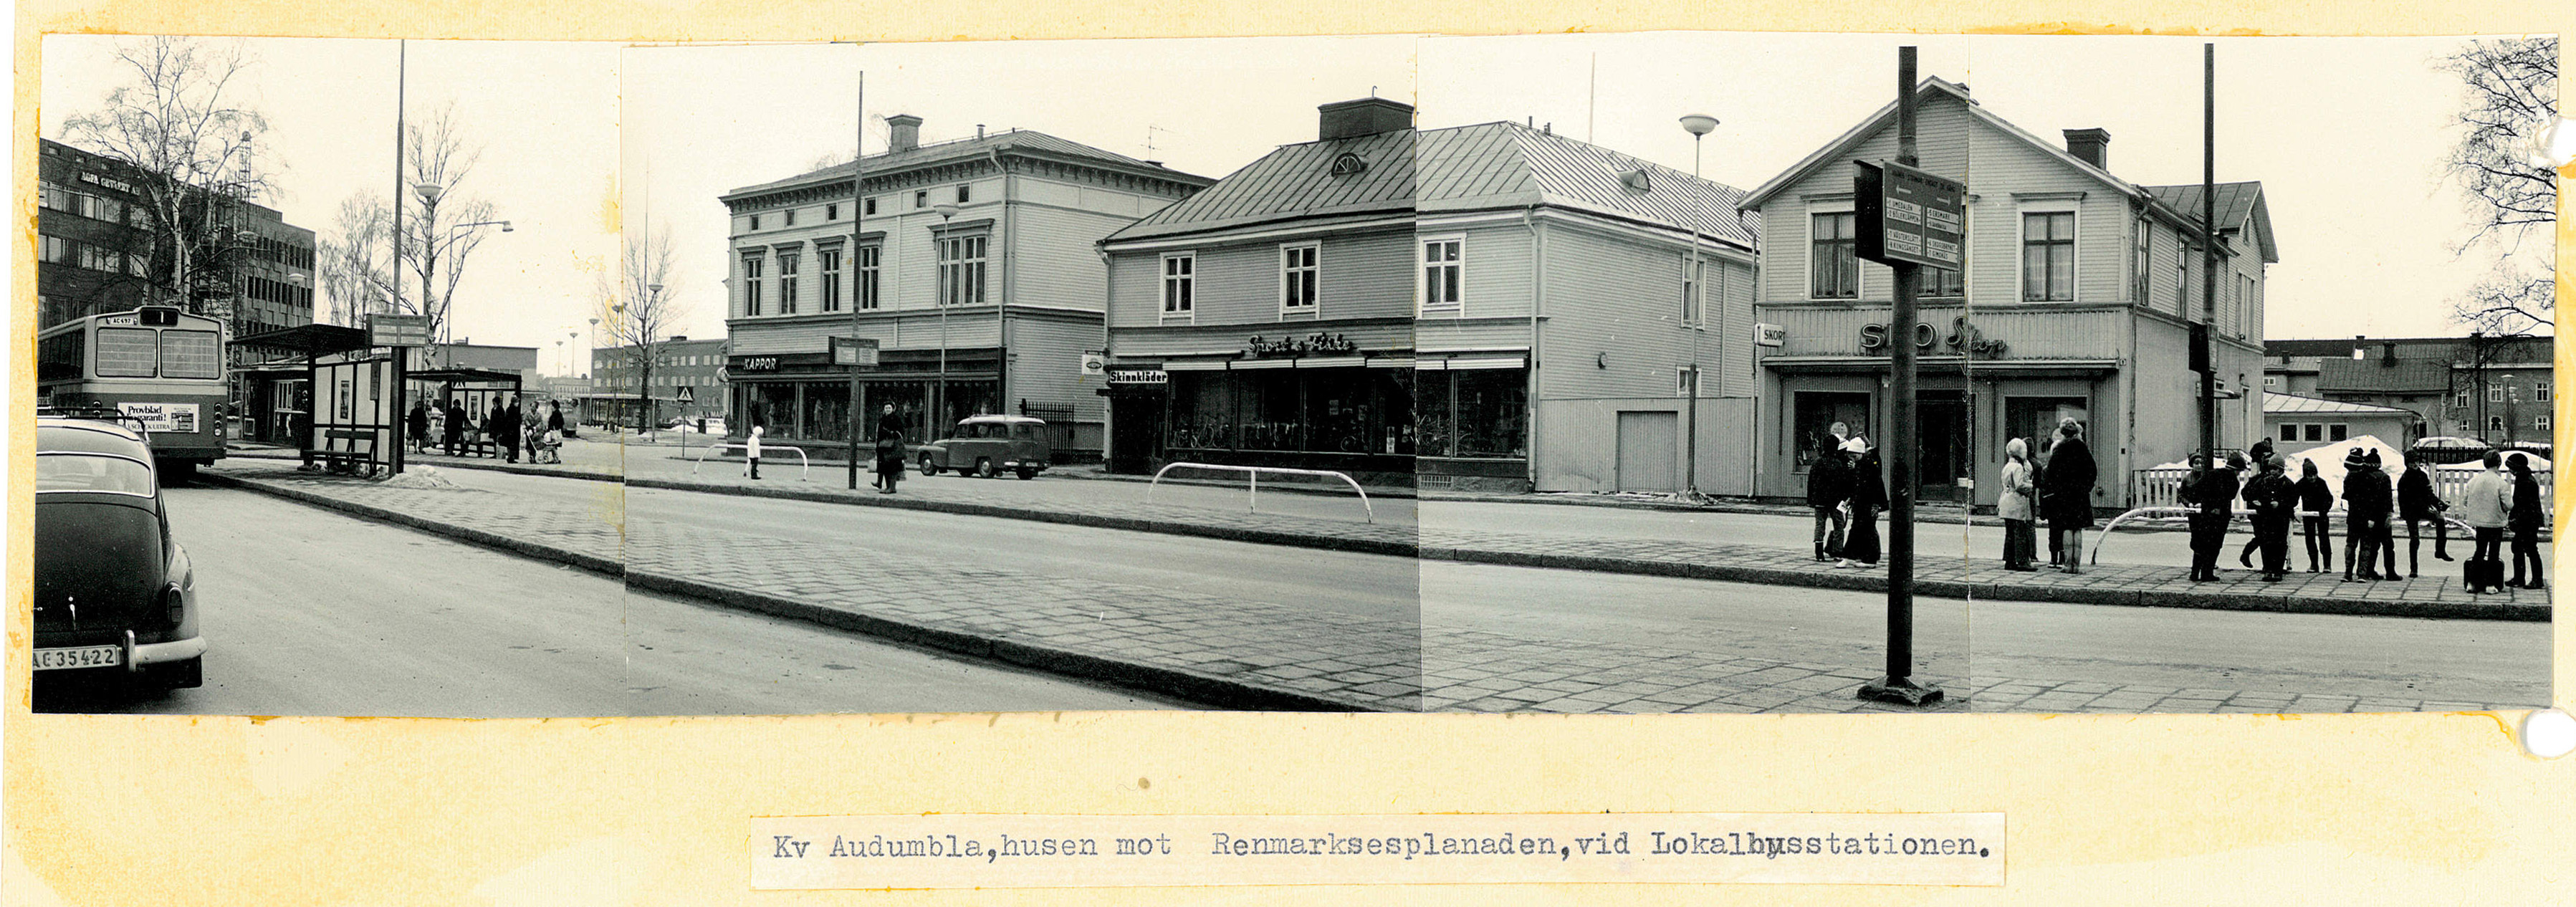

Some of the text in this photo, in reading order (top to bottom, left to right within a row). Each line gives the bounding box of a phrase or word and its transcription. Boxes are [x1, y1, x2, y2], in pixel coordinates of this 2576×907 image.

[1764, 330, 1783, 341] SKOR
[1861, 322, 1938, 349] SO
[1248, 335, 1289, 357] Sport
[1306, 332, 1351, 352] Fiske
[744, 358, 776, 370] KAPPOR
[1110, 372, 1167, 382] Skinnkläder
[128, 405, 162, 414] Provblad
[773, 835, 810, 858] Kv
[829, 834, 1098, 863] Audumbla,husen
[1116, 833, 1170, 855] mot
[1212, 831, 1630, 860] Renmarksesplanaden,vid
